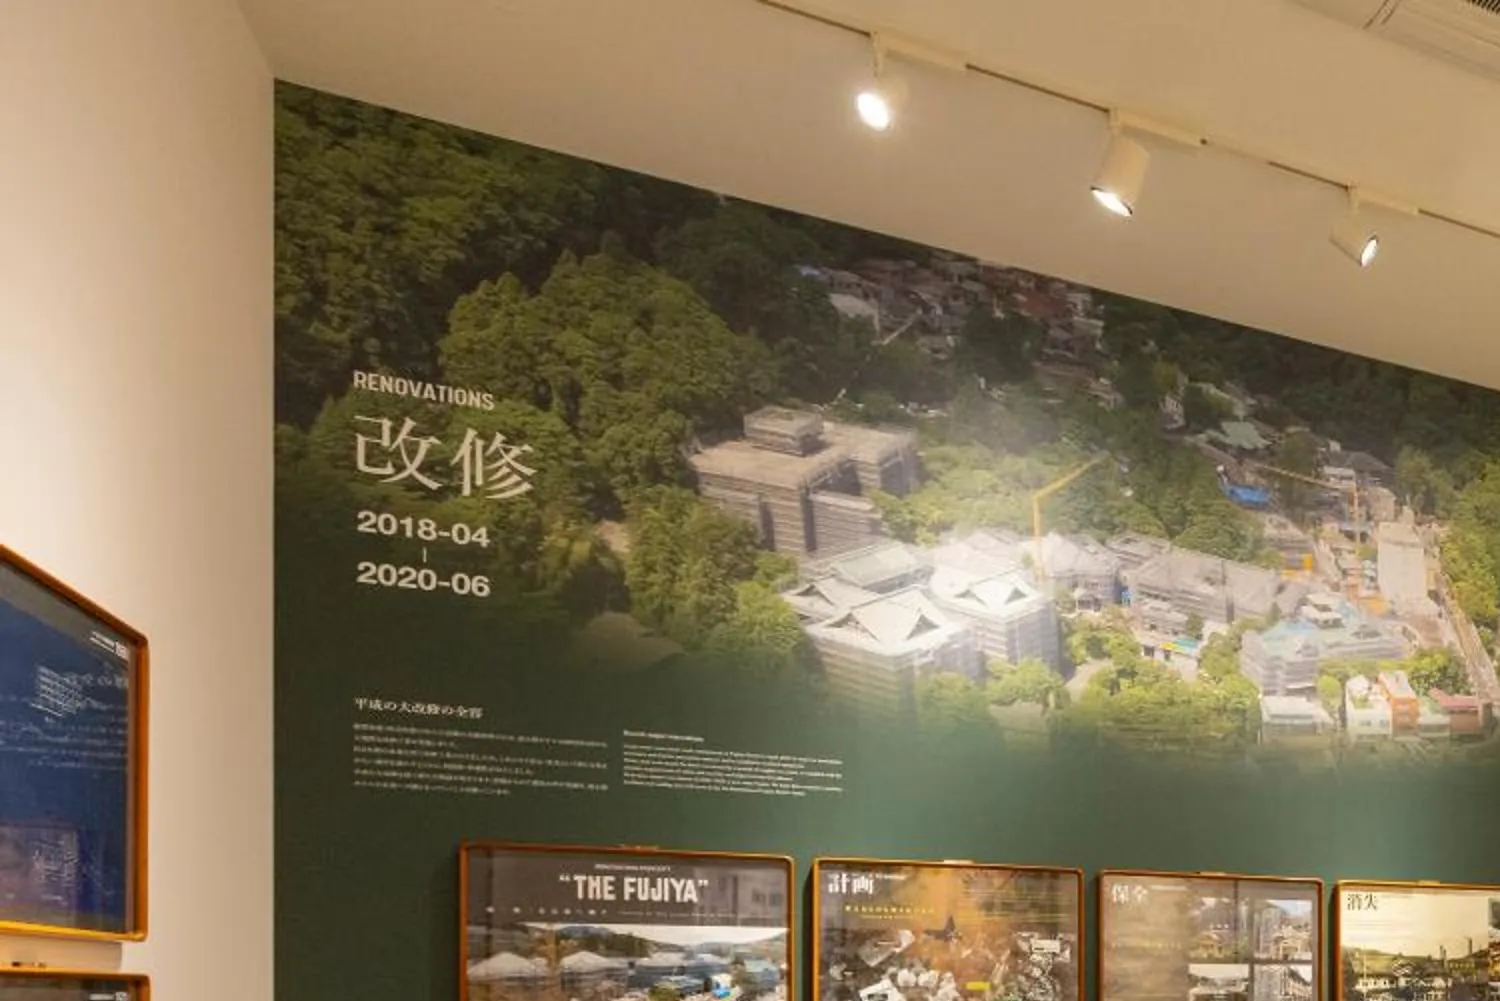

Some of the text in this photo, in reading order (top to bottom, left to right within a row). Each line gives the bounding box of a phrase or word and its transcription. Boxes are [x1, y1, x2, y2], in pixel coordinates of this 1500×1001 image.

[353, 371, 495, 411] RENOVATIONS
[354, 415, 537, 499] 改修
[357, 510, 491, 548] 2018-04
[357, 561, 491, 598] 2020-06
